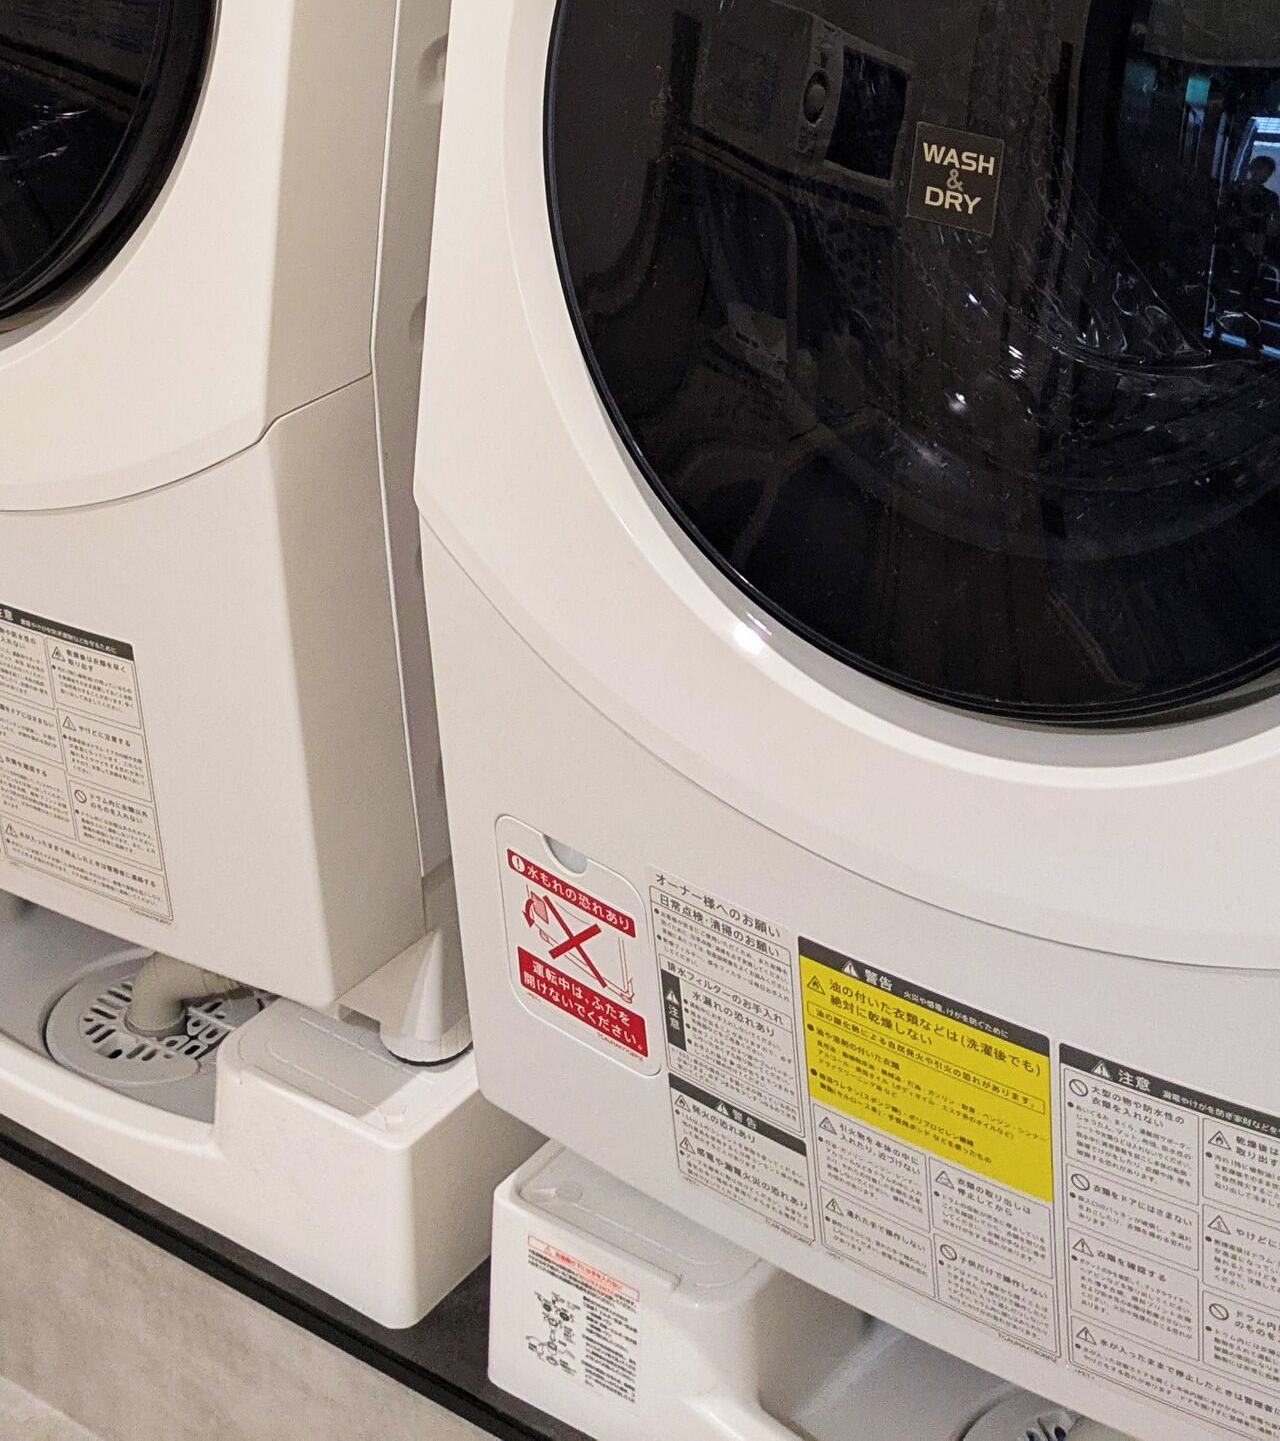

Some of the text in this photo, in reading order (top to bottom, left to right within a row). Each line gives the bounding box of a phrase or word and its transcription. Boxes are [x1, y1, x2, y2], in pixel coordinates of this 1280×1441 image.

[923, 142, 994, 176] WASH
[924, 186, 982, 214] DRY
[946, 168, 963, 192] &
[527, 864, 630, 930] 水もれの恐れあり
[656, 873, 781, 938] オーナー様へのお願い
[532, 960, 631, 1026] 運転中は、ふたを
[864, 968, 892, 992] 警告
[524, 973, 645, 1051] 開けないでください。
[830, 994, 932, 1046] 絶対に乾燥しない
[1118, 1069, 1152, 1092] 注意
[1091, 1085, 1184, 1125] 大型の物や防水性の
[1092, 1098, 1164, 1126] 衣類を入れない
[1092, 1184, 1193, 1227] 衣類をドアにはさまない
